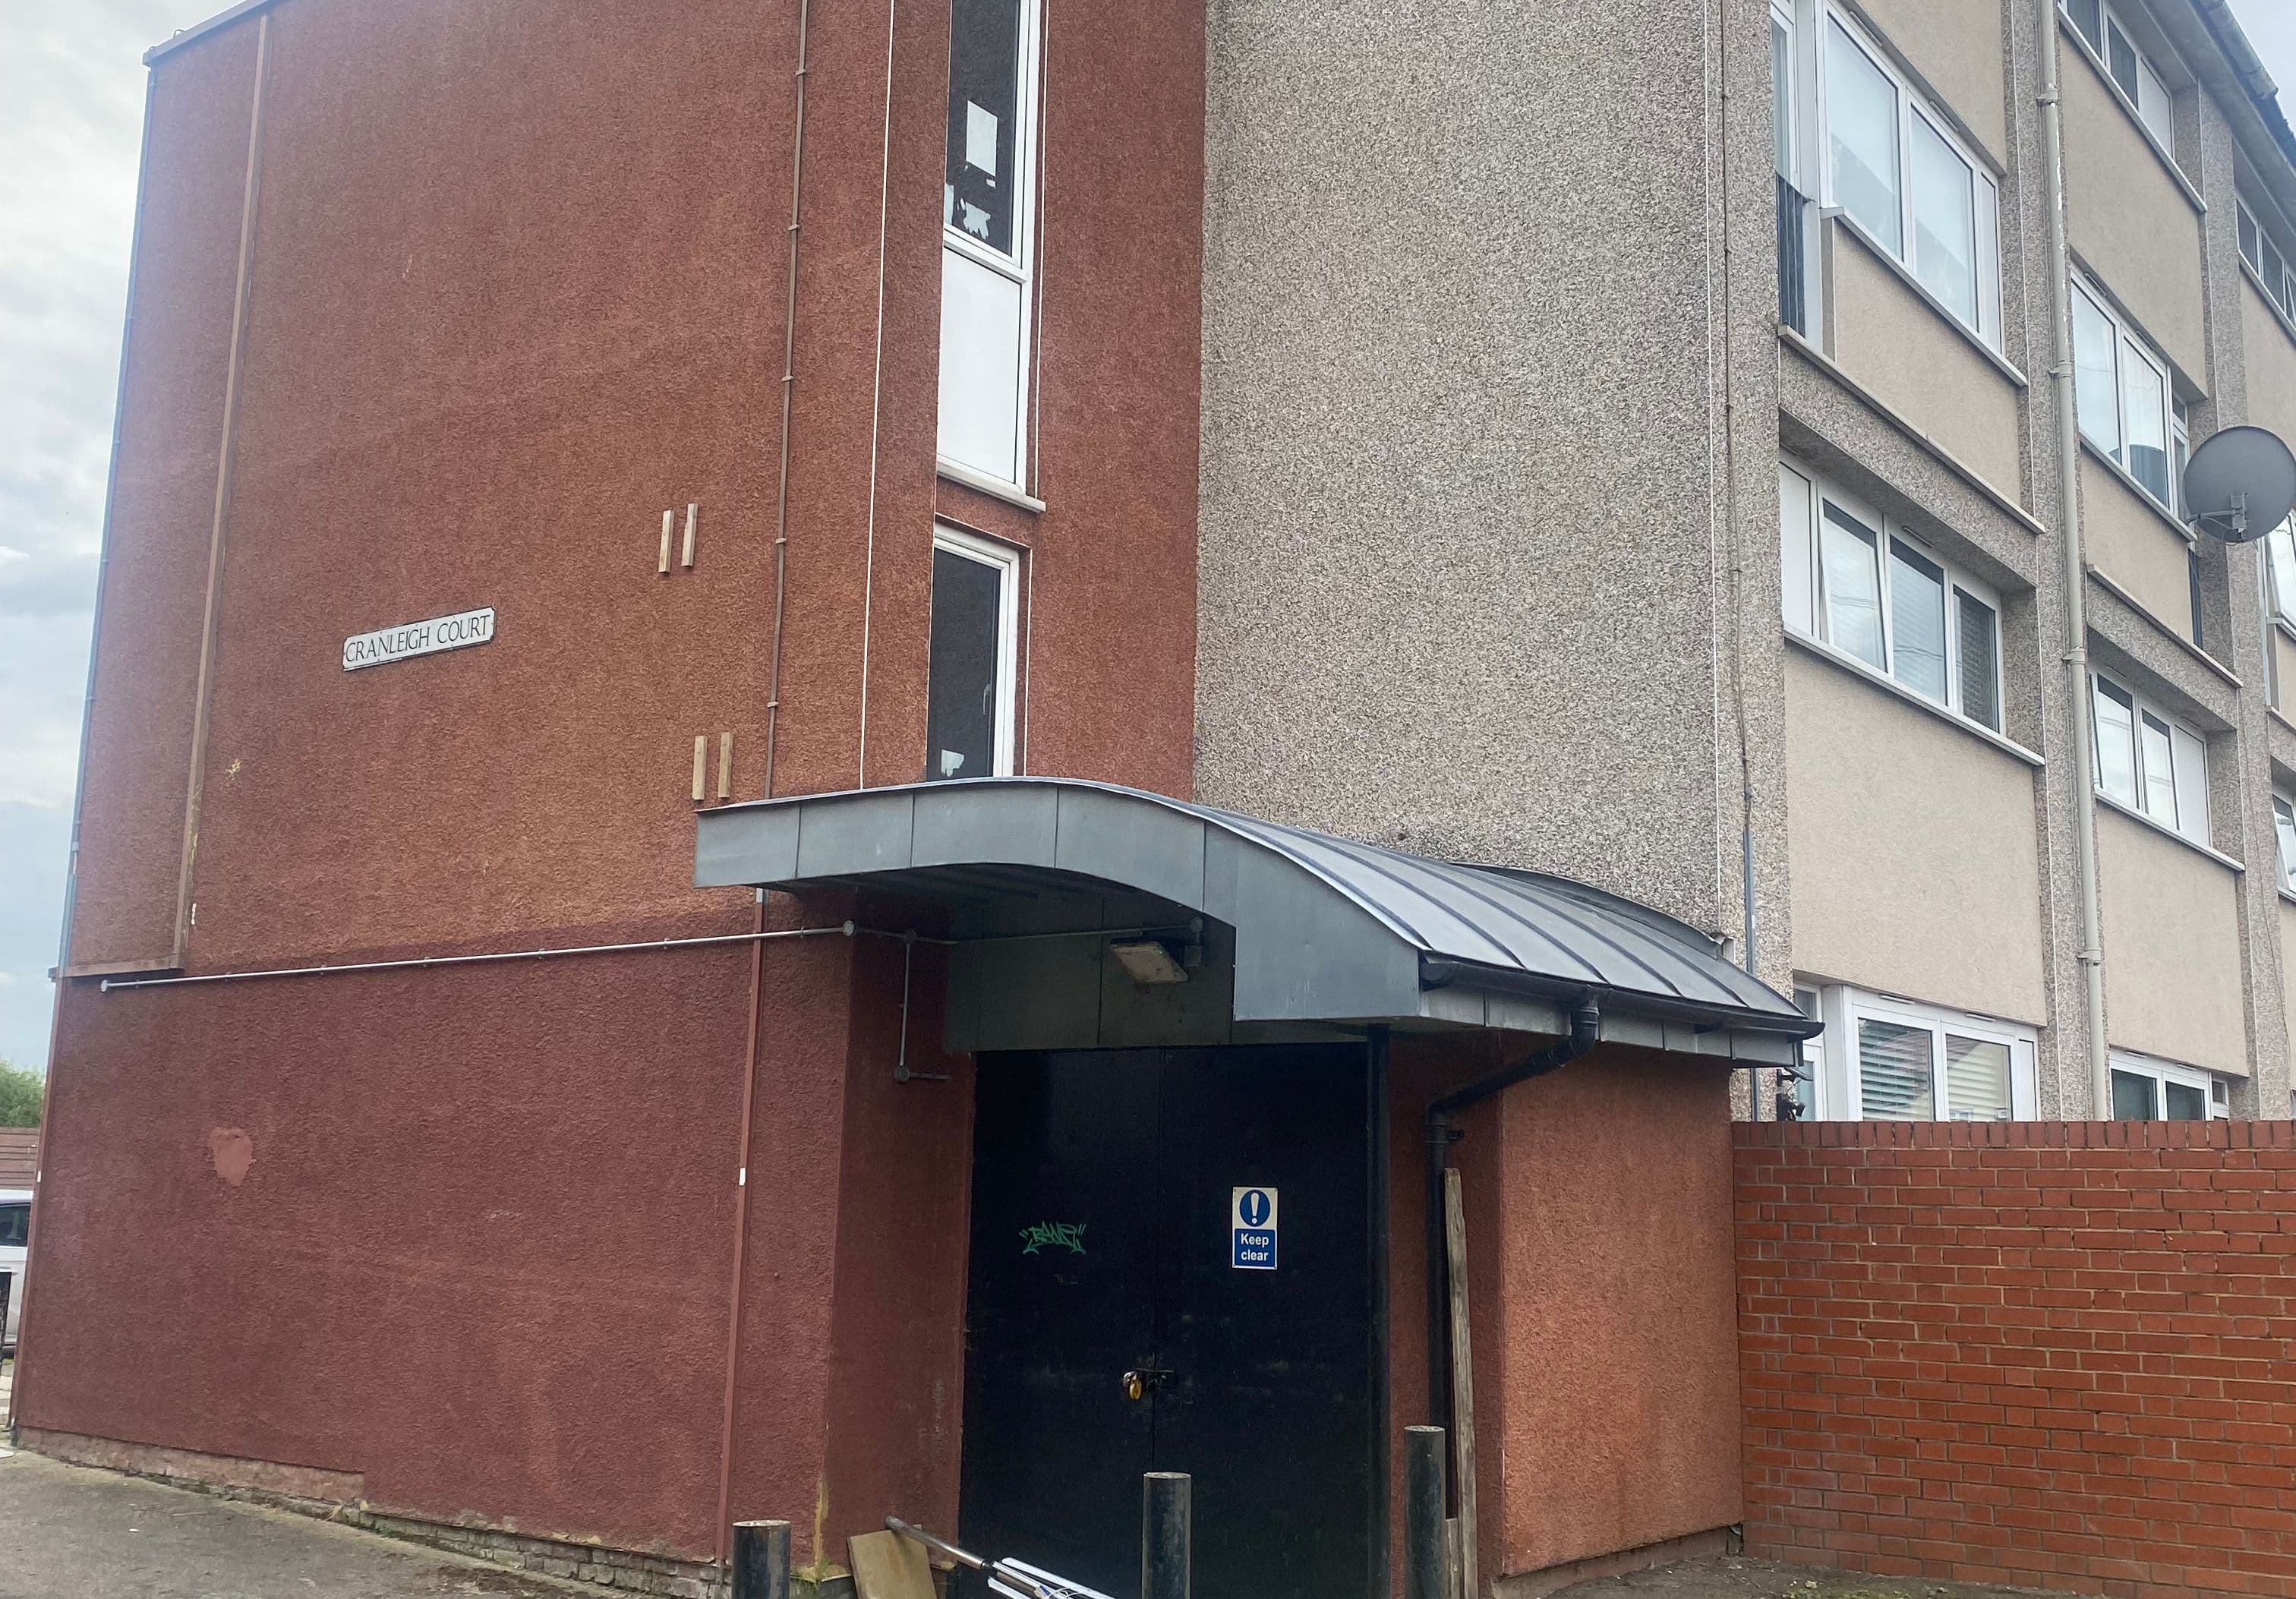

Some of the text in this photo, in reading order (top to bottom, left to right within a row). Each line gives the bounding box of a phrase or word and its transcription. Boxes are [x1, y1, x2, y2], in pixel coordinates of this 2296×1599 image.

[345, 615, 490, 662] CRANLEIGH COURT
[1241, 1233, 1269, 1248] Keep
[1241, 1249, 1269, 1261] clear
